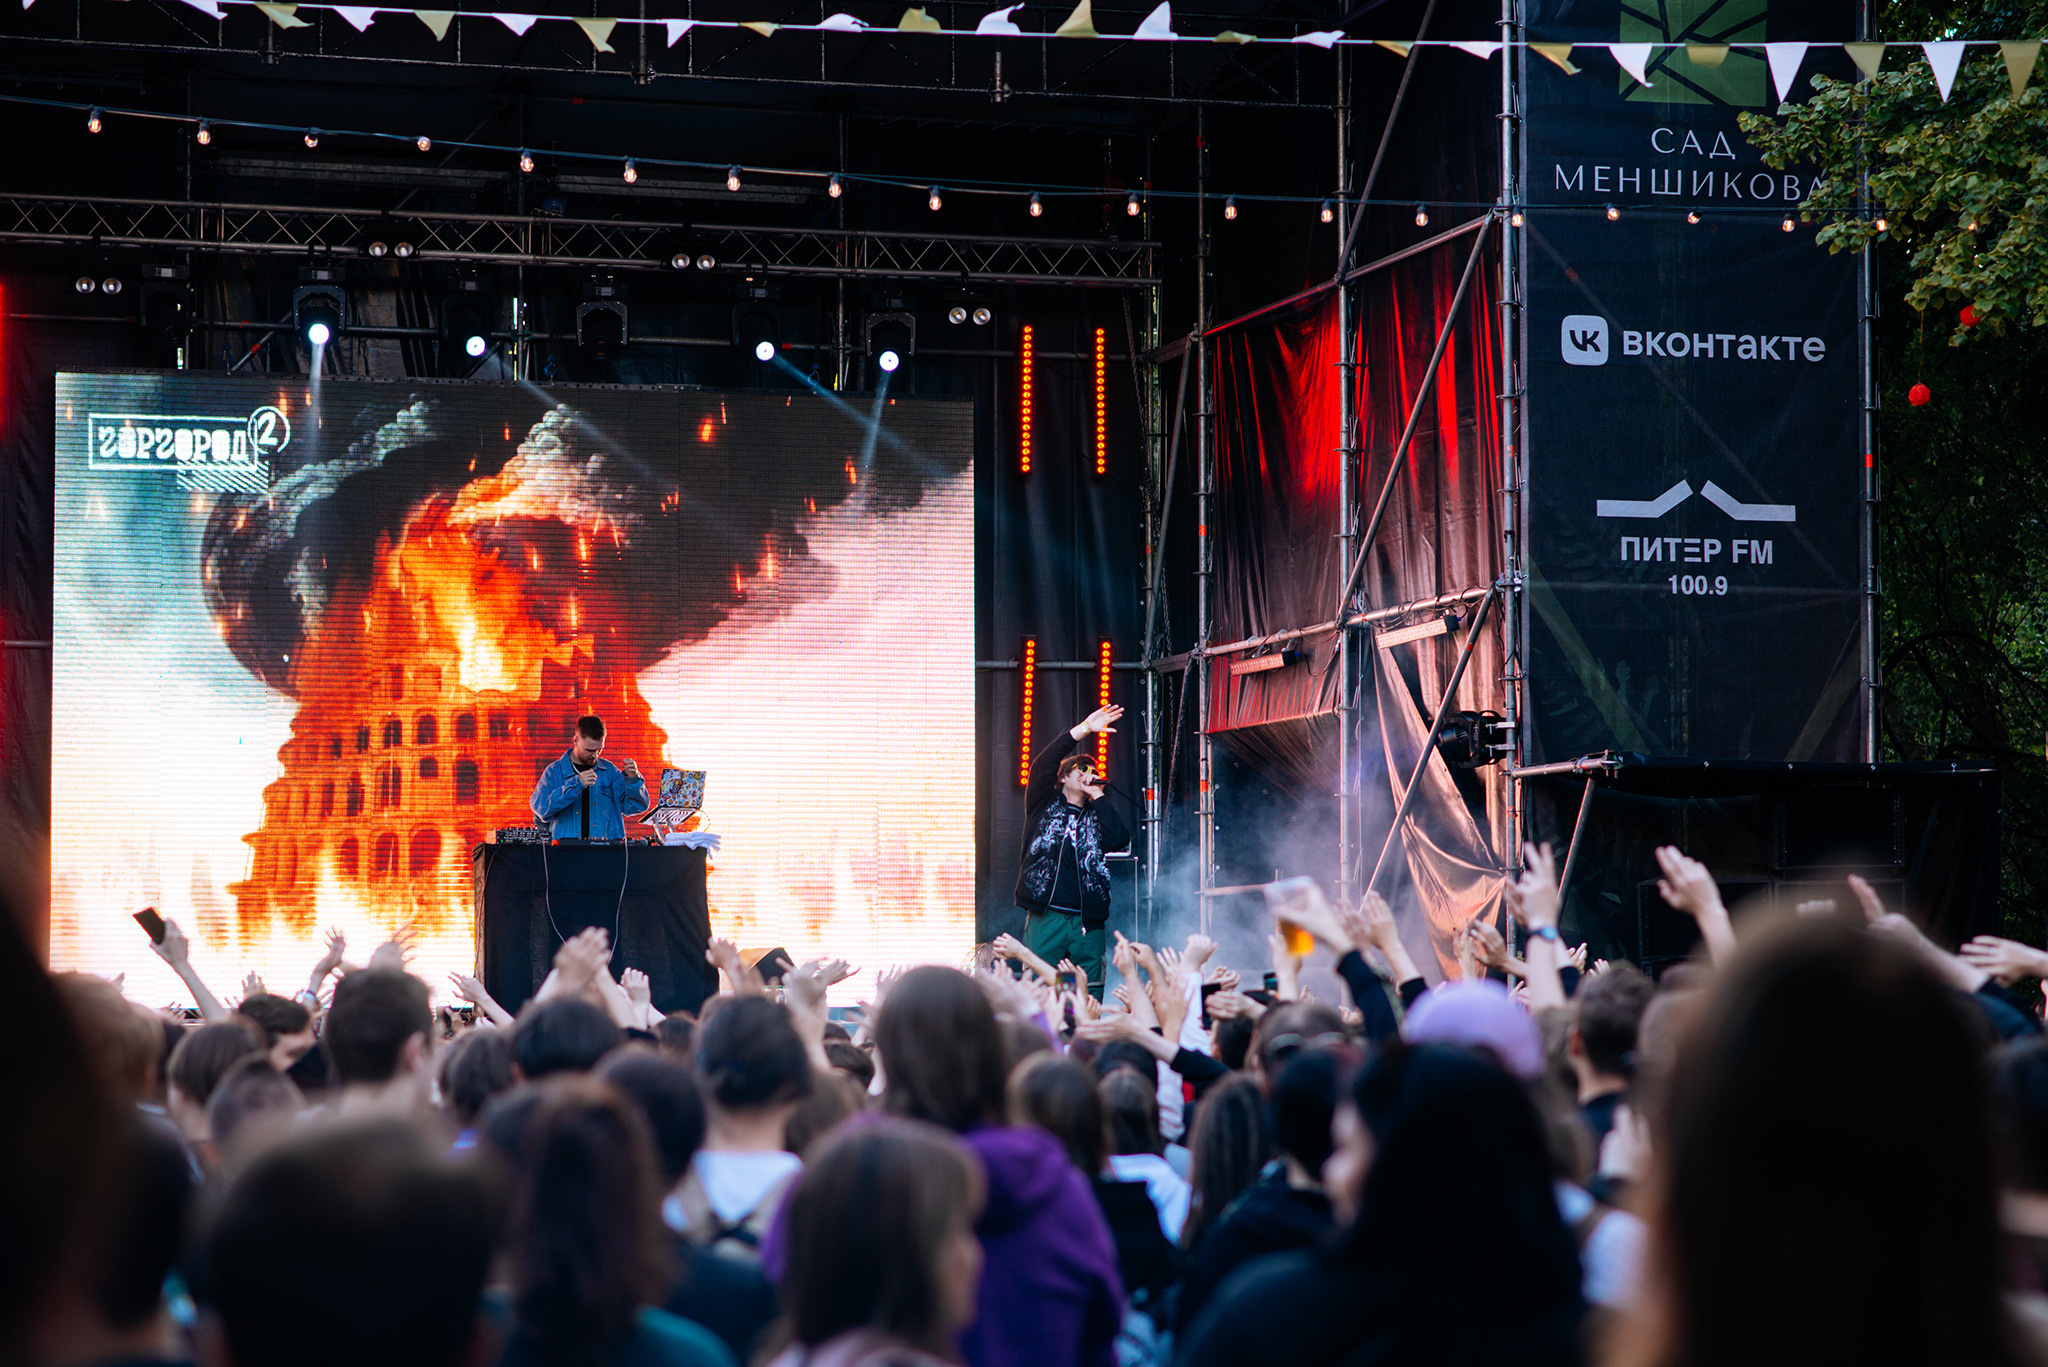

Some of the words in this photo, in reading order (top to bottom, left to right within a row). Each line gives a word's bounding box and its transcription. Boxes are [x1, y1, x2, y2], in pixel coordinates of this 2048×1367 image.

[1651, 127, 1736, 160] САД
[257, 411, 279, 446] 2
[1620, 536, 1722, 563] ПИТЕР
[1732, 539, 1773, 565] FM
[1668, 574, 1728, 596] 100.9
